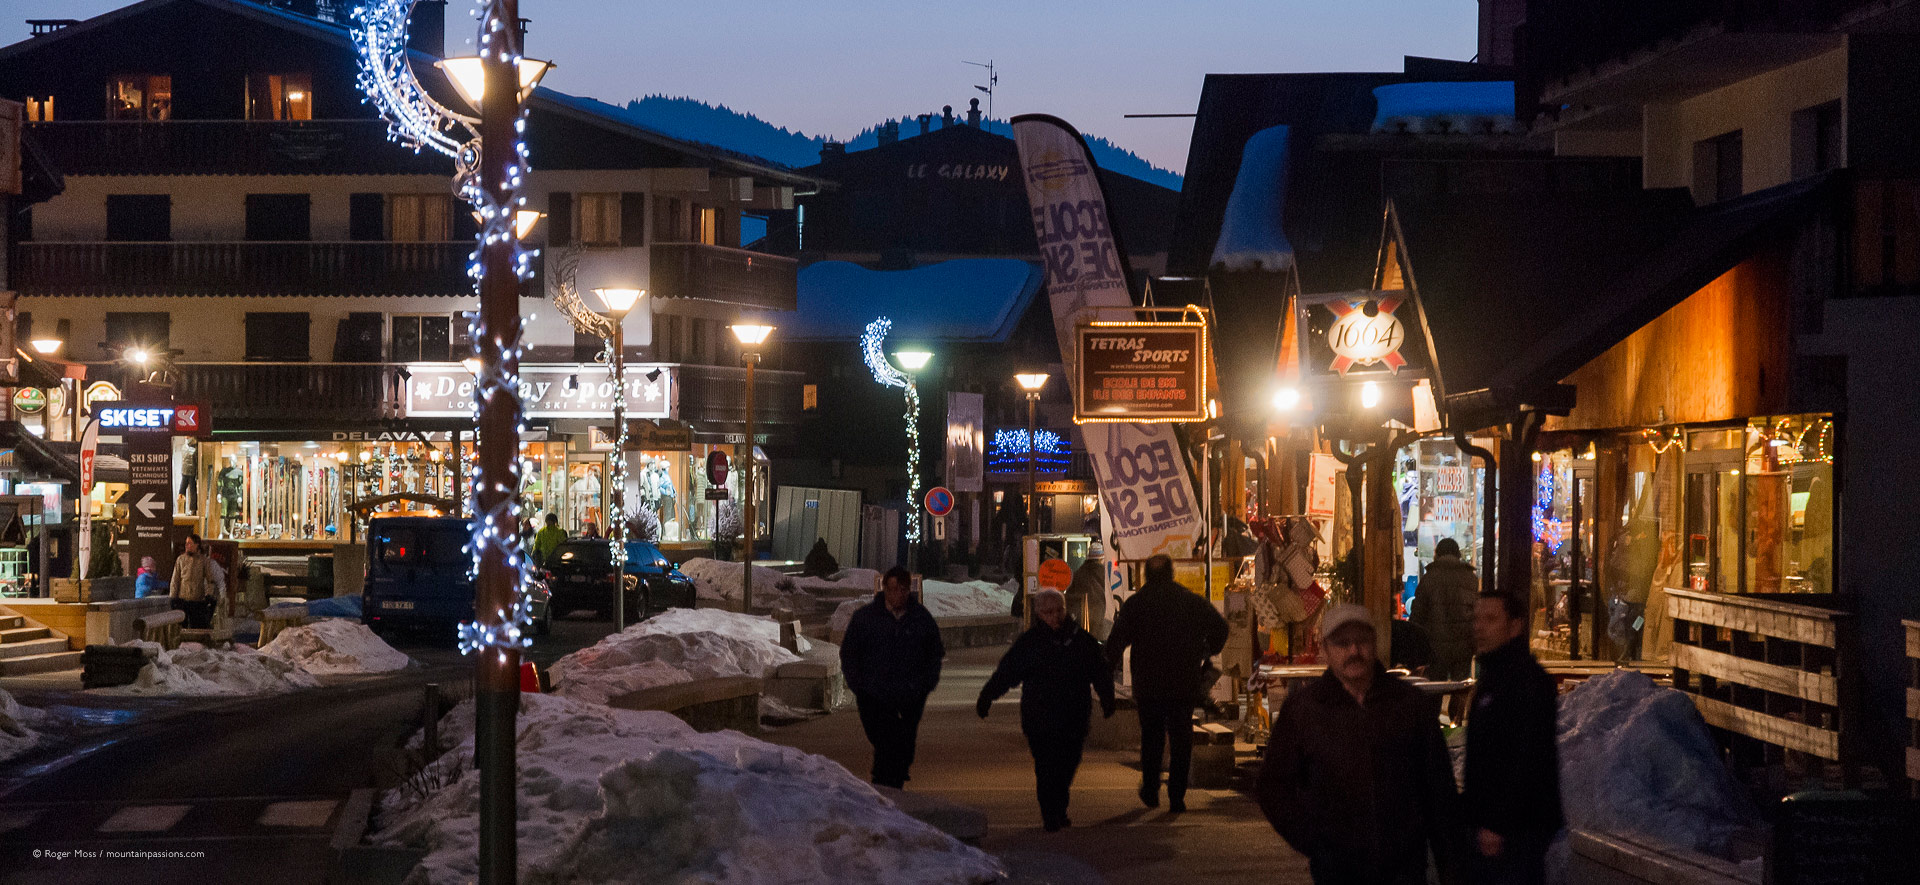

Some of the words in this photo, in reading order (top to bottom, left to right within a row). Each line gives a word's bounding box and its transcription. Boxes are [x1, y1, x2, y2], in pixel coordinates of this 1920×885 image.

[937, 164, 1009, 182] GALAXY
[1335, 319, 1400, 349] 1664
[1090, 337, 1146, 351] TETRAS
[1132, 349, 1190, 363] SPORTS
[1103, 377, 1138, 388] ECOLE
[1140, 377, 1155, 388] DE
[1157, 377, 1176, 388] SKI
[1093, 389, 1109, 400] ILE
[1112, 389, 1133, 400] DES
[1136, 389, 1187, 400] ENFANTS
[100, 408, 174, 427] SKISET
[333, 431, 435, 441] DELAVAY
[725, 435, 746, 443] DELAVA
[753, 434, 767, 444] PORT
[131, 454, 145, 463] SKI
[147, 454, 169, 463] SHOP
